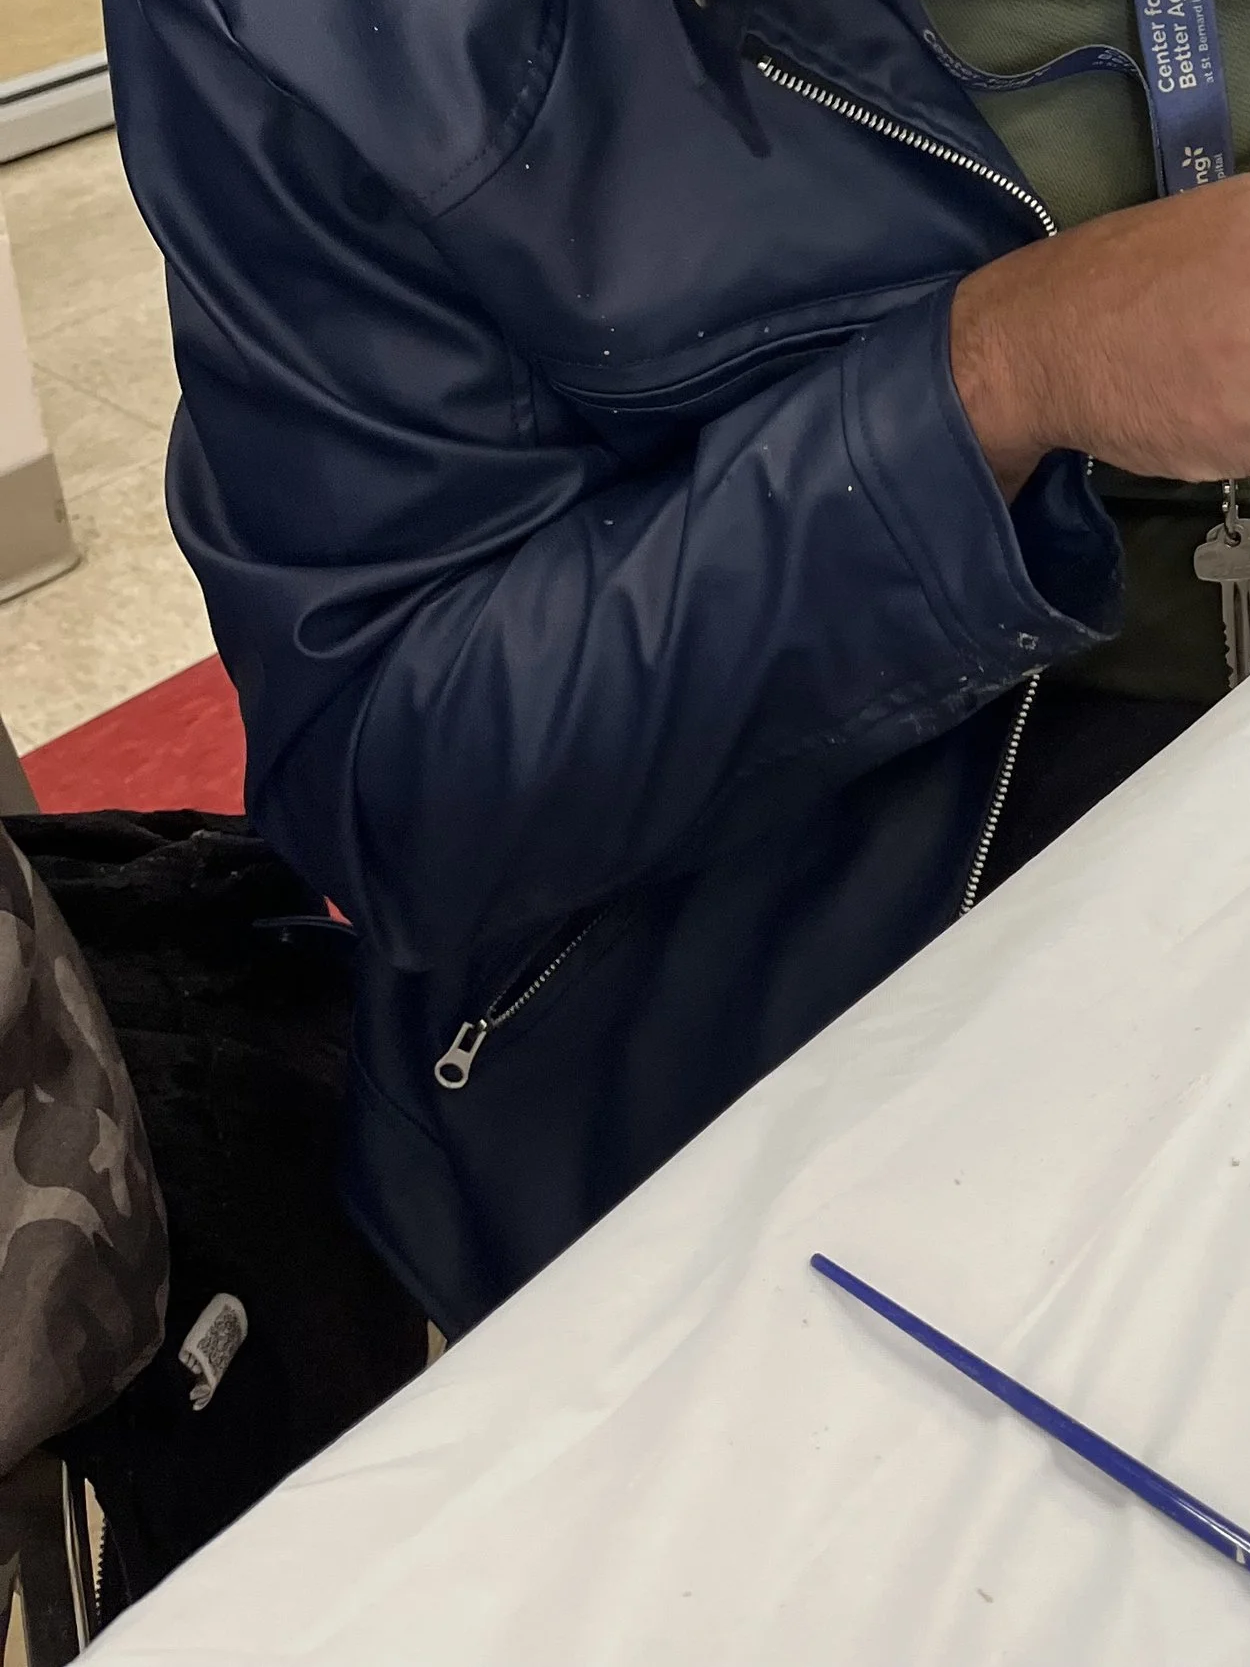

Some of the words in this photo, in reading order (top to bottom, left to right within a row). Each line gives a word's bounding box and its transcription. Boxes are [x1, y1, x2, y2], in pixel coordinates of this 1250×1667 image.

[1193, 5, 1209, 51] Bernard
[1151, 22, 1175, 93] Center
[1174, 23, 1197, 89] Better
[1204, 71, 1214, 83] at
[1213, 153, 1226, 179] pital
